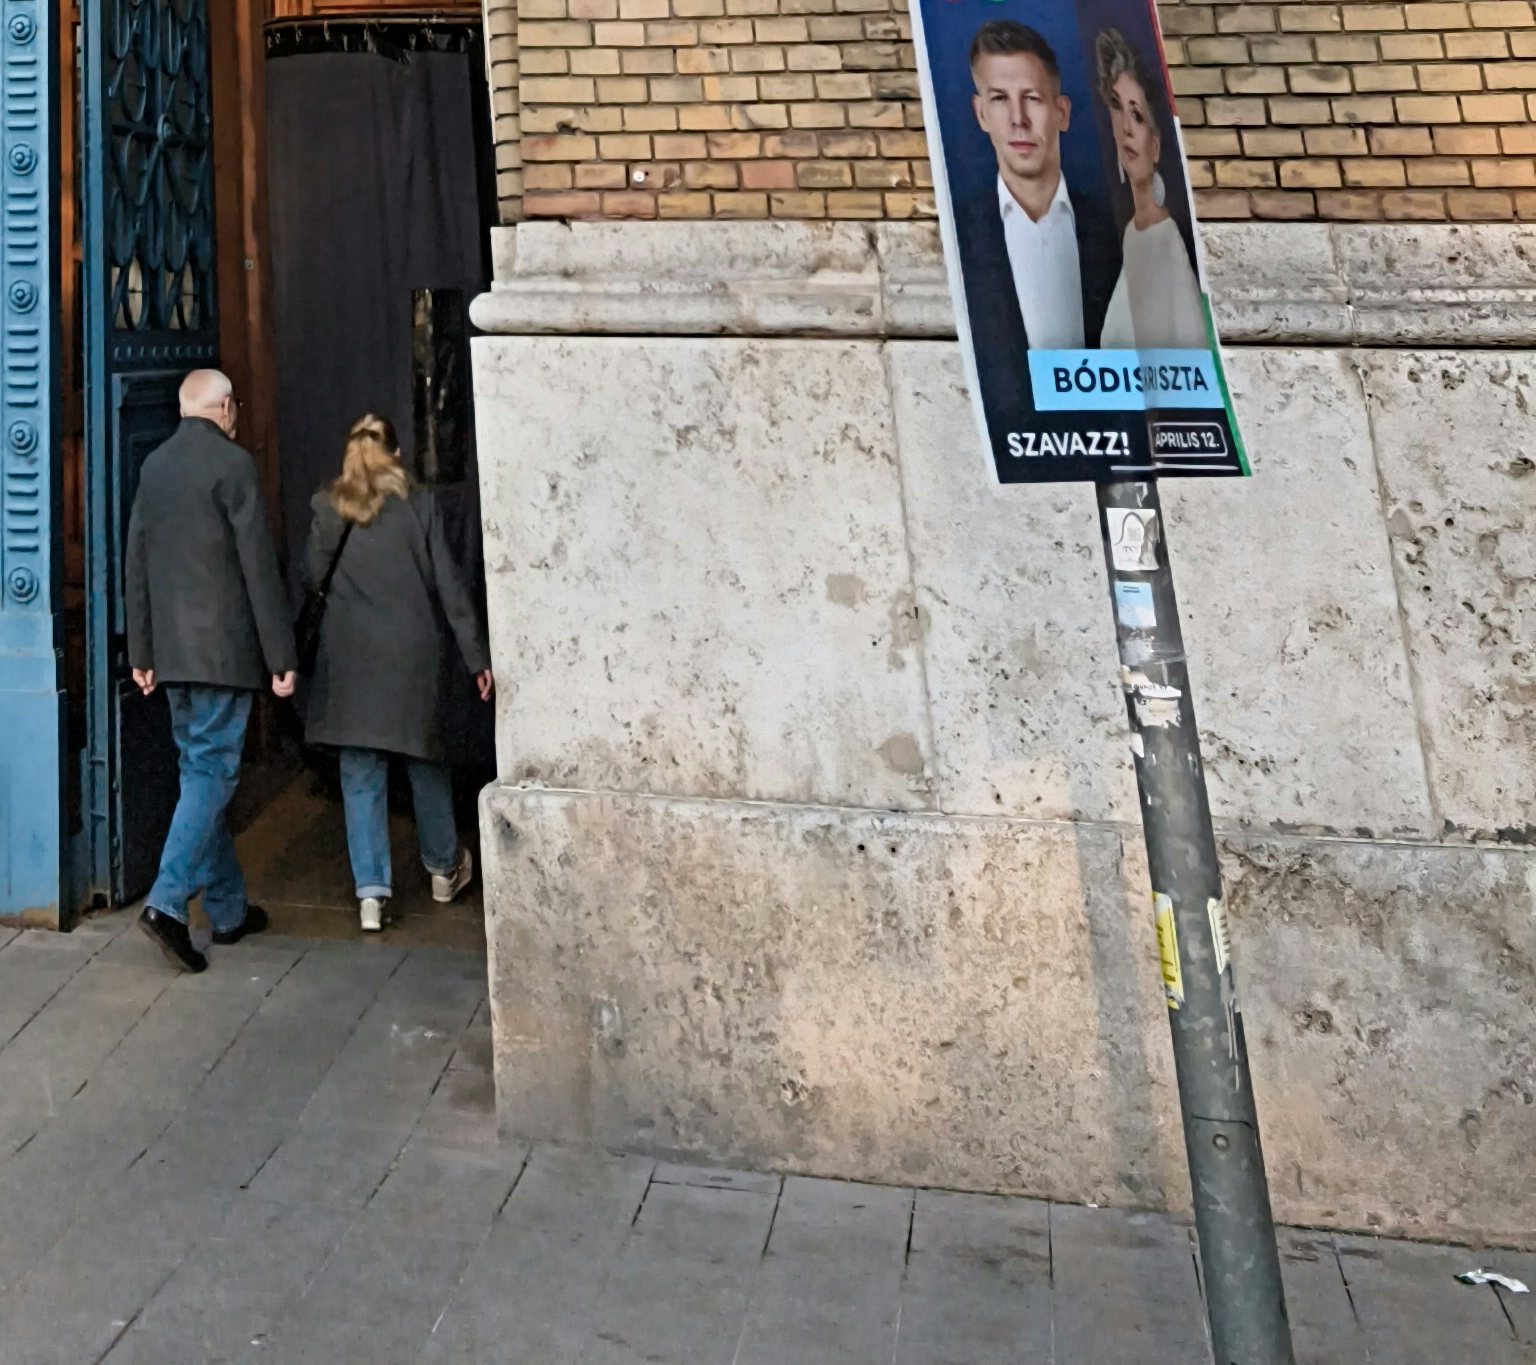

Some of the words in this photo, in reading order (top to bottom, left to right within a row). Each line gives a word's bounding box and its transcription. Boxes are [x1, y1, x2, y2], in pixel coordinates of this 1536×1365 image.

[1053, 359, 1144, 393] BÓDIS
[1007, 432, 1131, 457] SZAVAZZ!
[1155, 426, 1200, 448] ÁPRILIS
[1200, 431, 1220, 448] 12.
